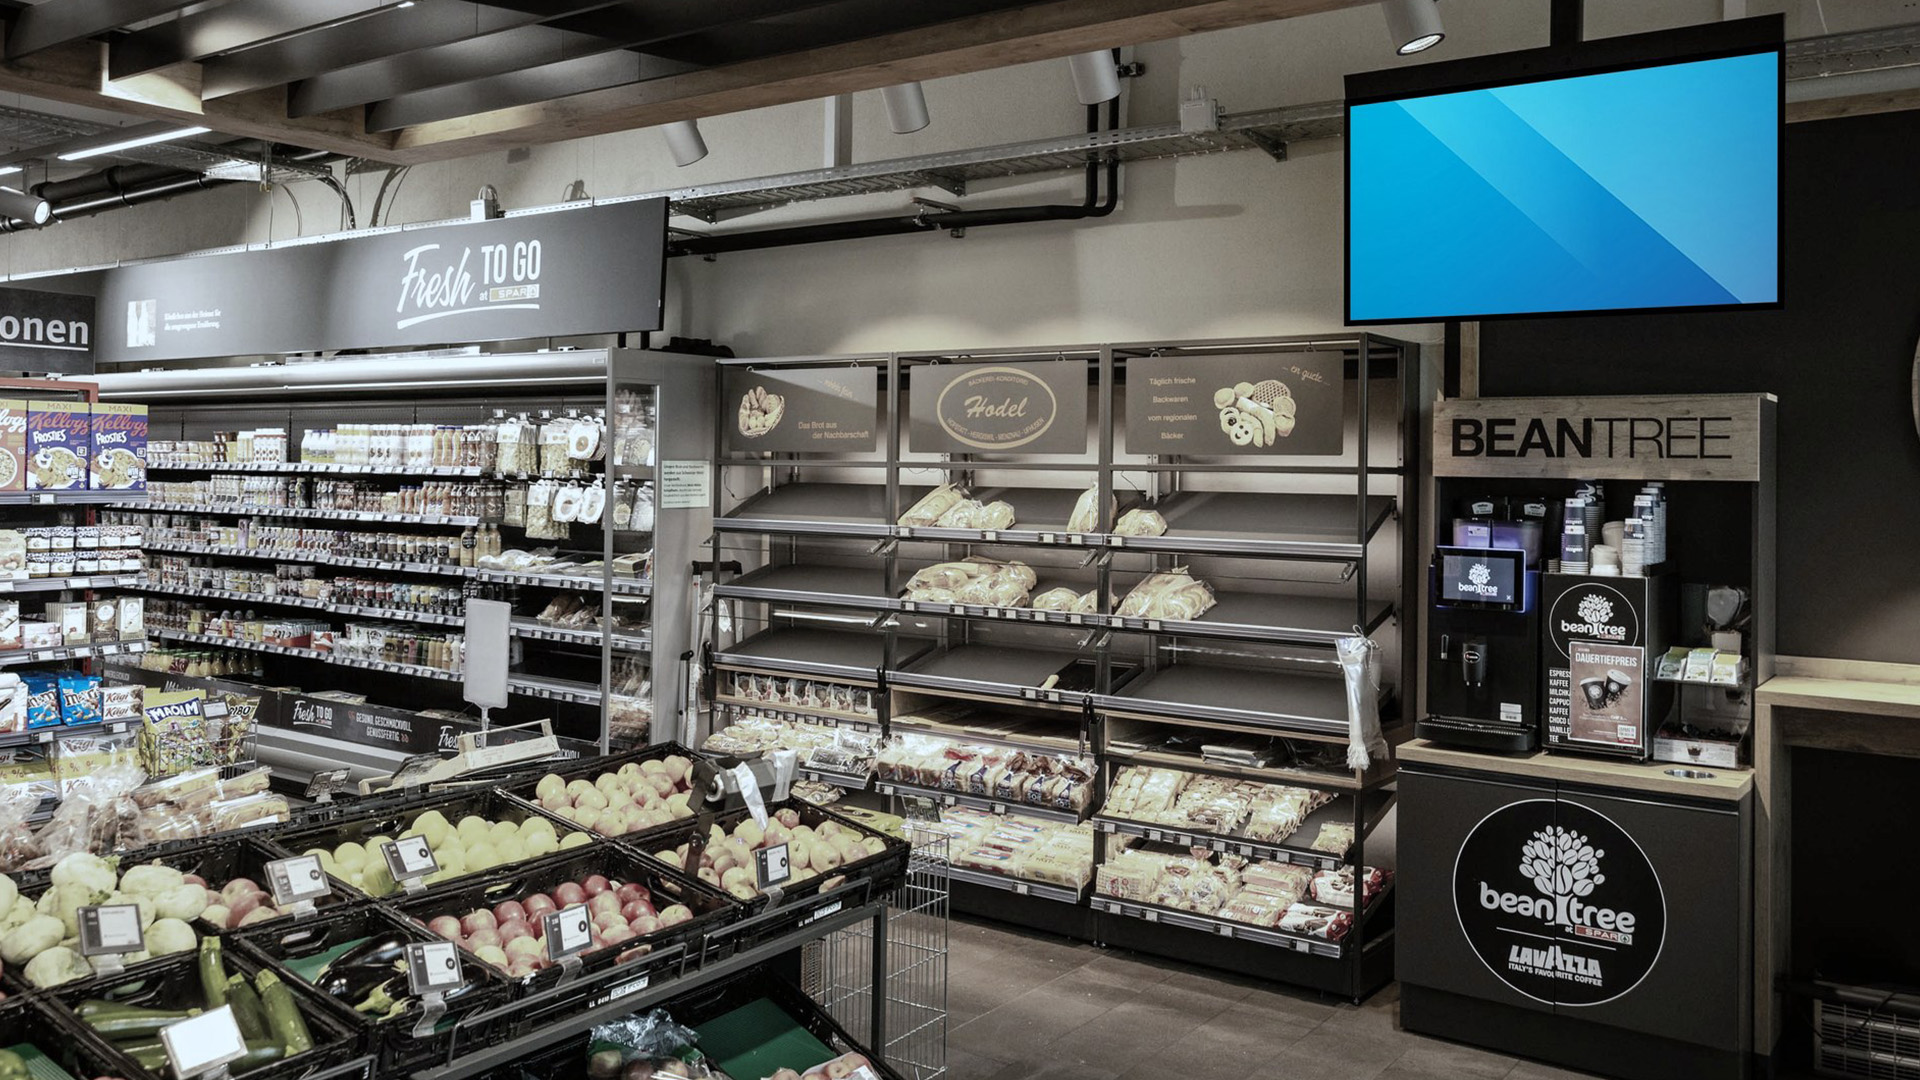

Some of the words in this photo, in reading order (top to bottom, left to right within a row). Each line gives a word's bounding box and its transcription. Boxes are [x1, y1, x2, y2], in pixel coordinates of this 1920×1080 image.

[397, 244, 476, 312] Fresh
[481, 244, 507, 285] TO
[513, 240, 541, 281] GO
[479, 291, 488, 301] at
[498, 288, 527, 299] SPAR
[0, 315, 89, 345] onen
[1149, 377, 1173, 386] Täglich
[964, 395, 1028, 418] Hodel
[811, 421, 824, 429] Brot
[1162, 413, 1197, 422] regionalen
[33, 429, 67, 444] FROSTIES
[95, 430, 127, 445] FROSTIES
[812, 431, 823, 439] der
[824, 430, 869, 438] Nachbarschaft
[1452, 417, 1732, 459] BEANTREE
[1458, 582, 1478, 592] bean
[1561, 620, 1592, 634] bean
[1600, 623, 1626, 635] tree
[1575, 652, 1637, 667] DAUERTIEFPREIS
[1549, 679, 1568, 687] KAFFEE
[1549, 688, 1570, 696] MILCHK
[150, 701, 199, 722] MAOAM
[293, 700, 314, 721] Fresh
[316, 706, 325, 718] TO
[325, 707, 332, 719] GO
[1549, 707, 1568, 715] KAFFEE
[1549, 716, 1566, 724] CHOCO
[438, 725, 463, 749] Fres
[1549, 734, 1559, 742] TEE
[1480, 881, 1555, 922] bean
[1569, 897, 1636, 934] tree
[1565, 926, 1573, 934] at
[1585, 928, 1619, 941] SPAR
[1508, 944, 1603, 979] LAVAZZA
[1508, 962, 1533, 974] ITALY'S
[1574, 974, 1603, 987] COFFEE
